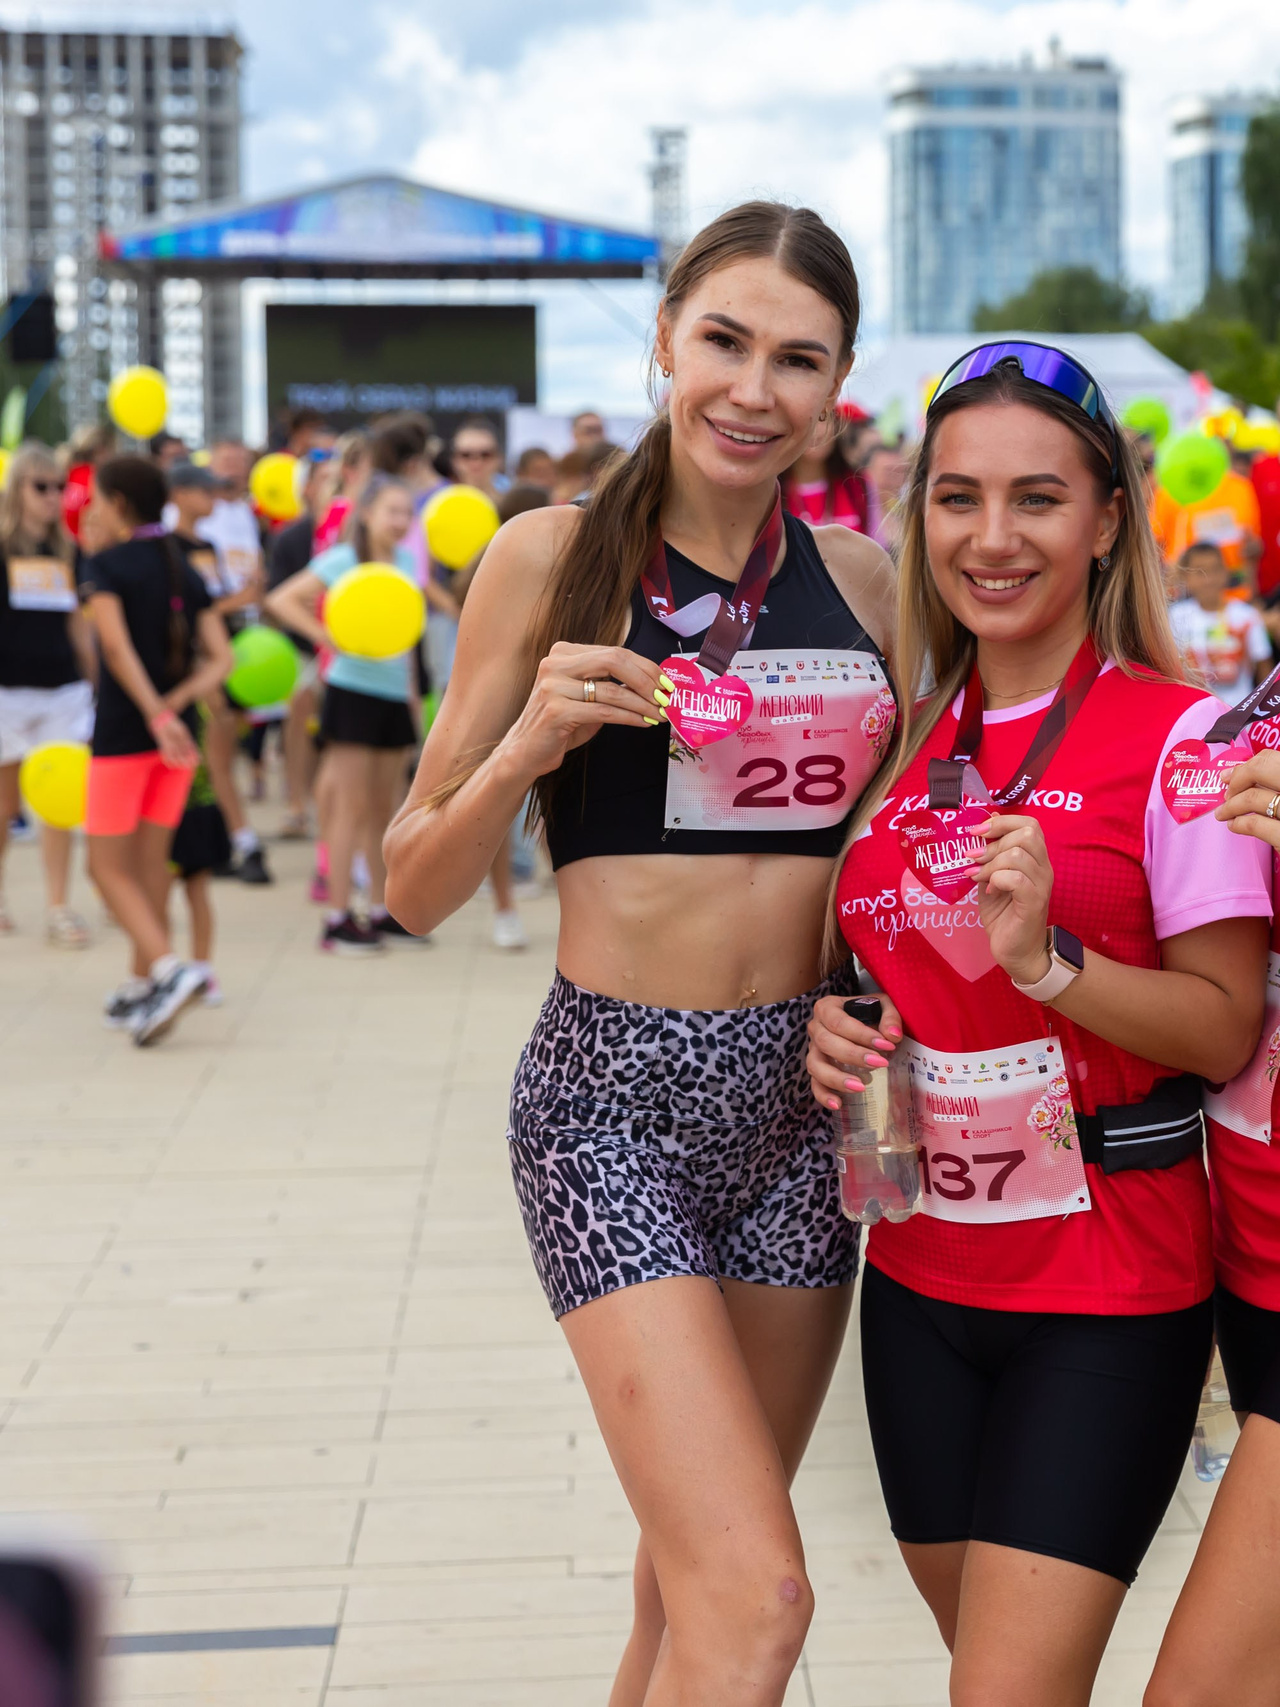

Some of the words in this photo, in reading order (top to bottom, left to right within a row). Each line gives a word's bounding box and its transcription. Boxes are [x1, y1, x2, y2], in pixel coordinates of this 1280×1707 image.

[669, 687, 740, 721] ЖЕНСКИЙ
[759, 693, 824, 718] ЖЕНСКИЙ
[733, 754, 846, 807] 28
[1006, 774, 1032, 800] СПОРТ
[1167, 768, 1228, 790] ЖЕНСК
[841, 888, 897, 917] клуб
[926, 1091, 980, 1117] ЖЕНСКИЙ
[972, 1126, 1012, 1135] КАЛАШНИКОВ
[917, 1146, 1026, 1202] 137
